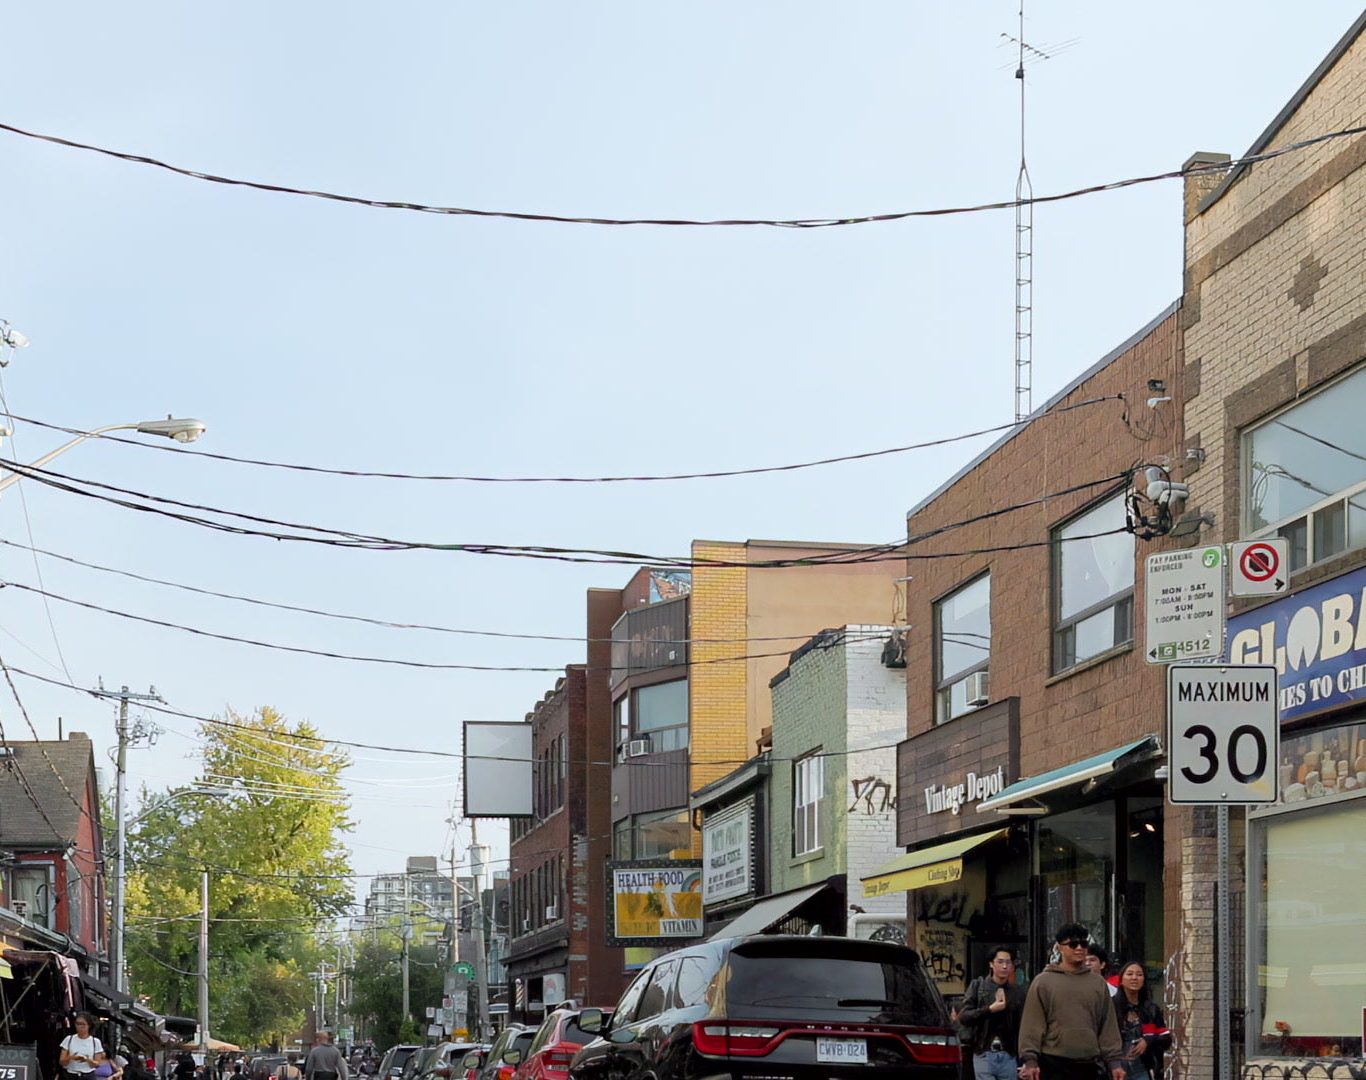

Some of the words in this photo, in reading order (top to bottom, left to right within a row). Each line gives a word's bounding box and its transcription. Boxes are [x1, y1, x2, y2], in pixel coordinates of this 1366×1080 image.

[1164, 552, 1193, 564] PARKING
[1150, 562, 1183, 574] ENFORCED
[1161, 586, 1182, 595] MON
[1190, 583, 1207, 592] SAT
[1175, 603, 1194, 613] SUN
[1177, 639, 1211, 653] 4512
[1178, 681, 1269, 702] MAXIMUM
[1310, 673, 1333, 700] TO
[1180, 724, 1268, 784] 30
[924, 783, 966, 815] Vintage
[966, 765, 1004, 801] Depot
[618, 872, 654, 888] HEALTH
[662, 920, 699, 934] VITAMIN
